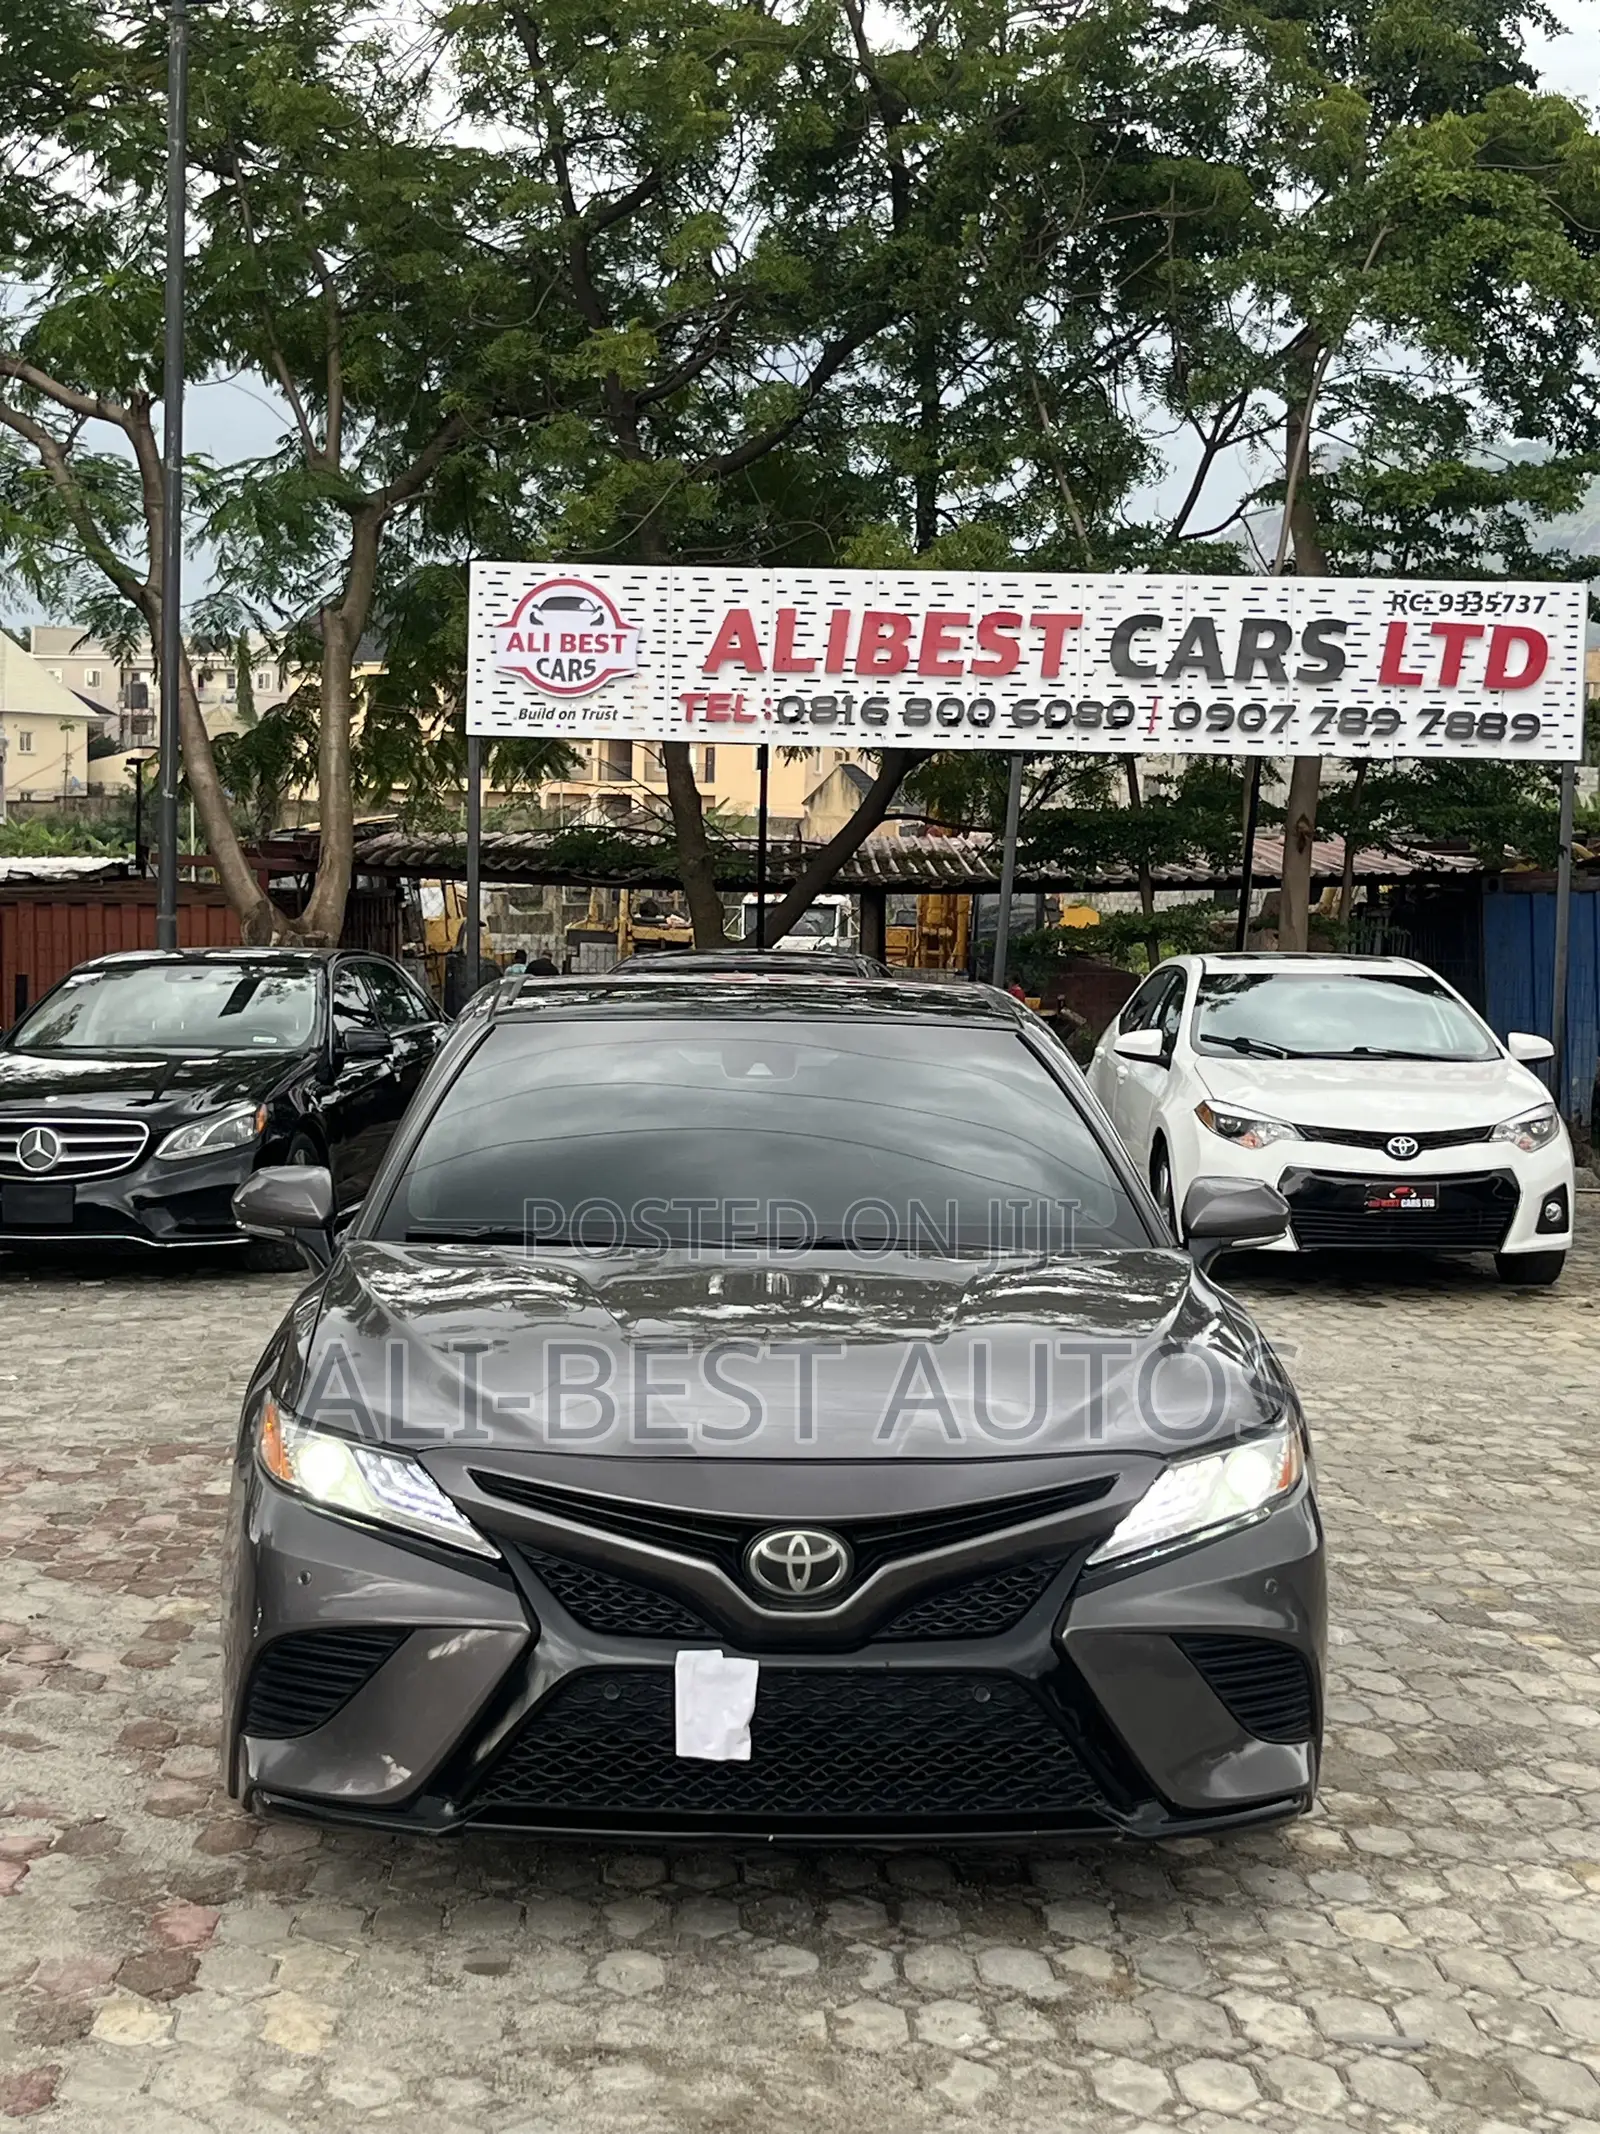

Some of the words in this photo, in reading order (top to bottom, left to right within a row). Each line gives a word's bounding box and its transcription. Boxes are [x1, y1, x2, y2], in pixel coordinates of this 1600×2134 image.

[1438, 593, 1547, 614] 9335737
[506, 632, 550, 653] ALI
[560, 632, 627, 654] BEST
[702, 608, 1083, 679] ALIBEST
[1109, 614, 1347, 684] CARS
[1378, 620, 1549, 690] LTD
[536, 657, 597, 682] CARS
[518, 707, 556, 721] Build
[558, 710, 576, 721] on
[582, 708, 619, 721] Trust
[902, 697, 996, 727] 800
[1011, 699, 1135, 729] 6080
[1172, 701, 1297, 735] 0907
[1310, 706, 1401, 737] 789
[1417, 708, 1541, 743] 7889
